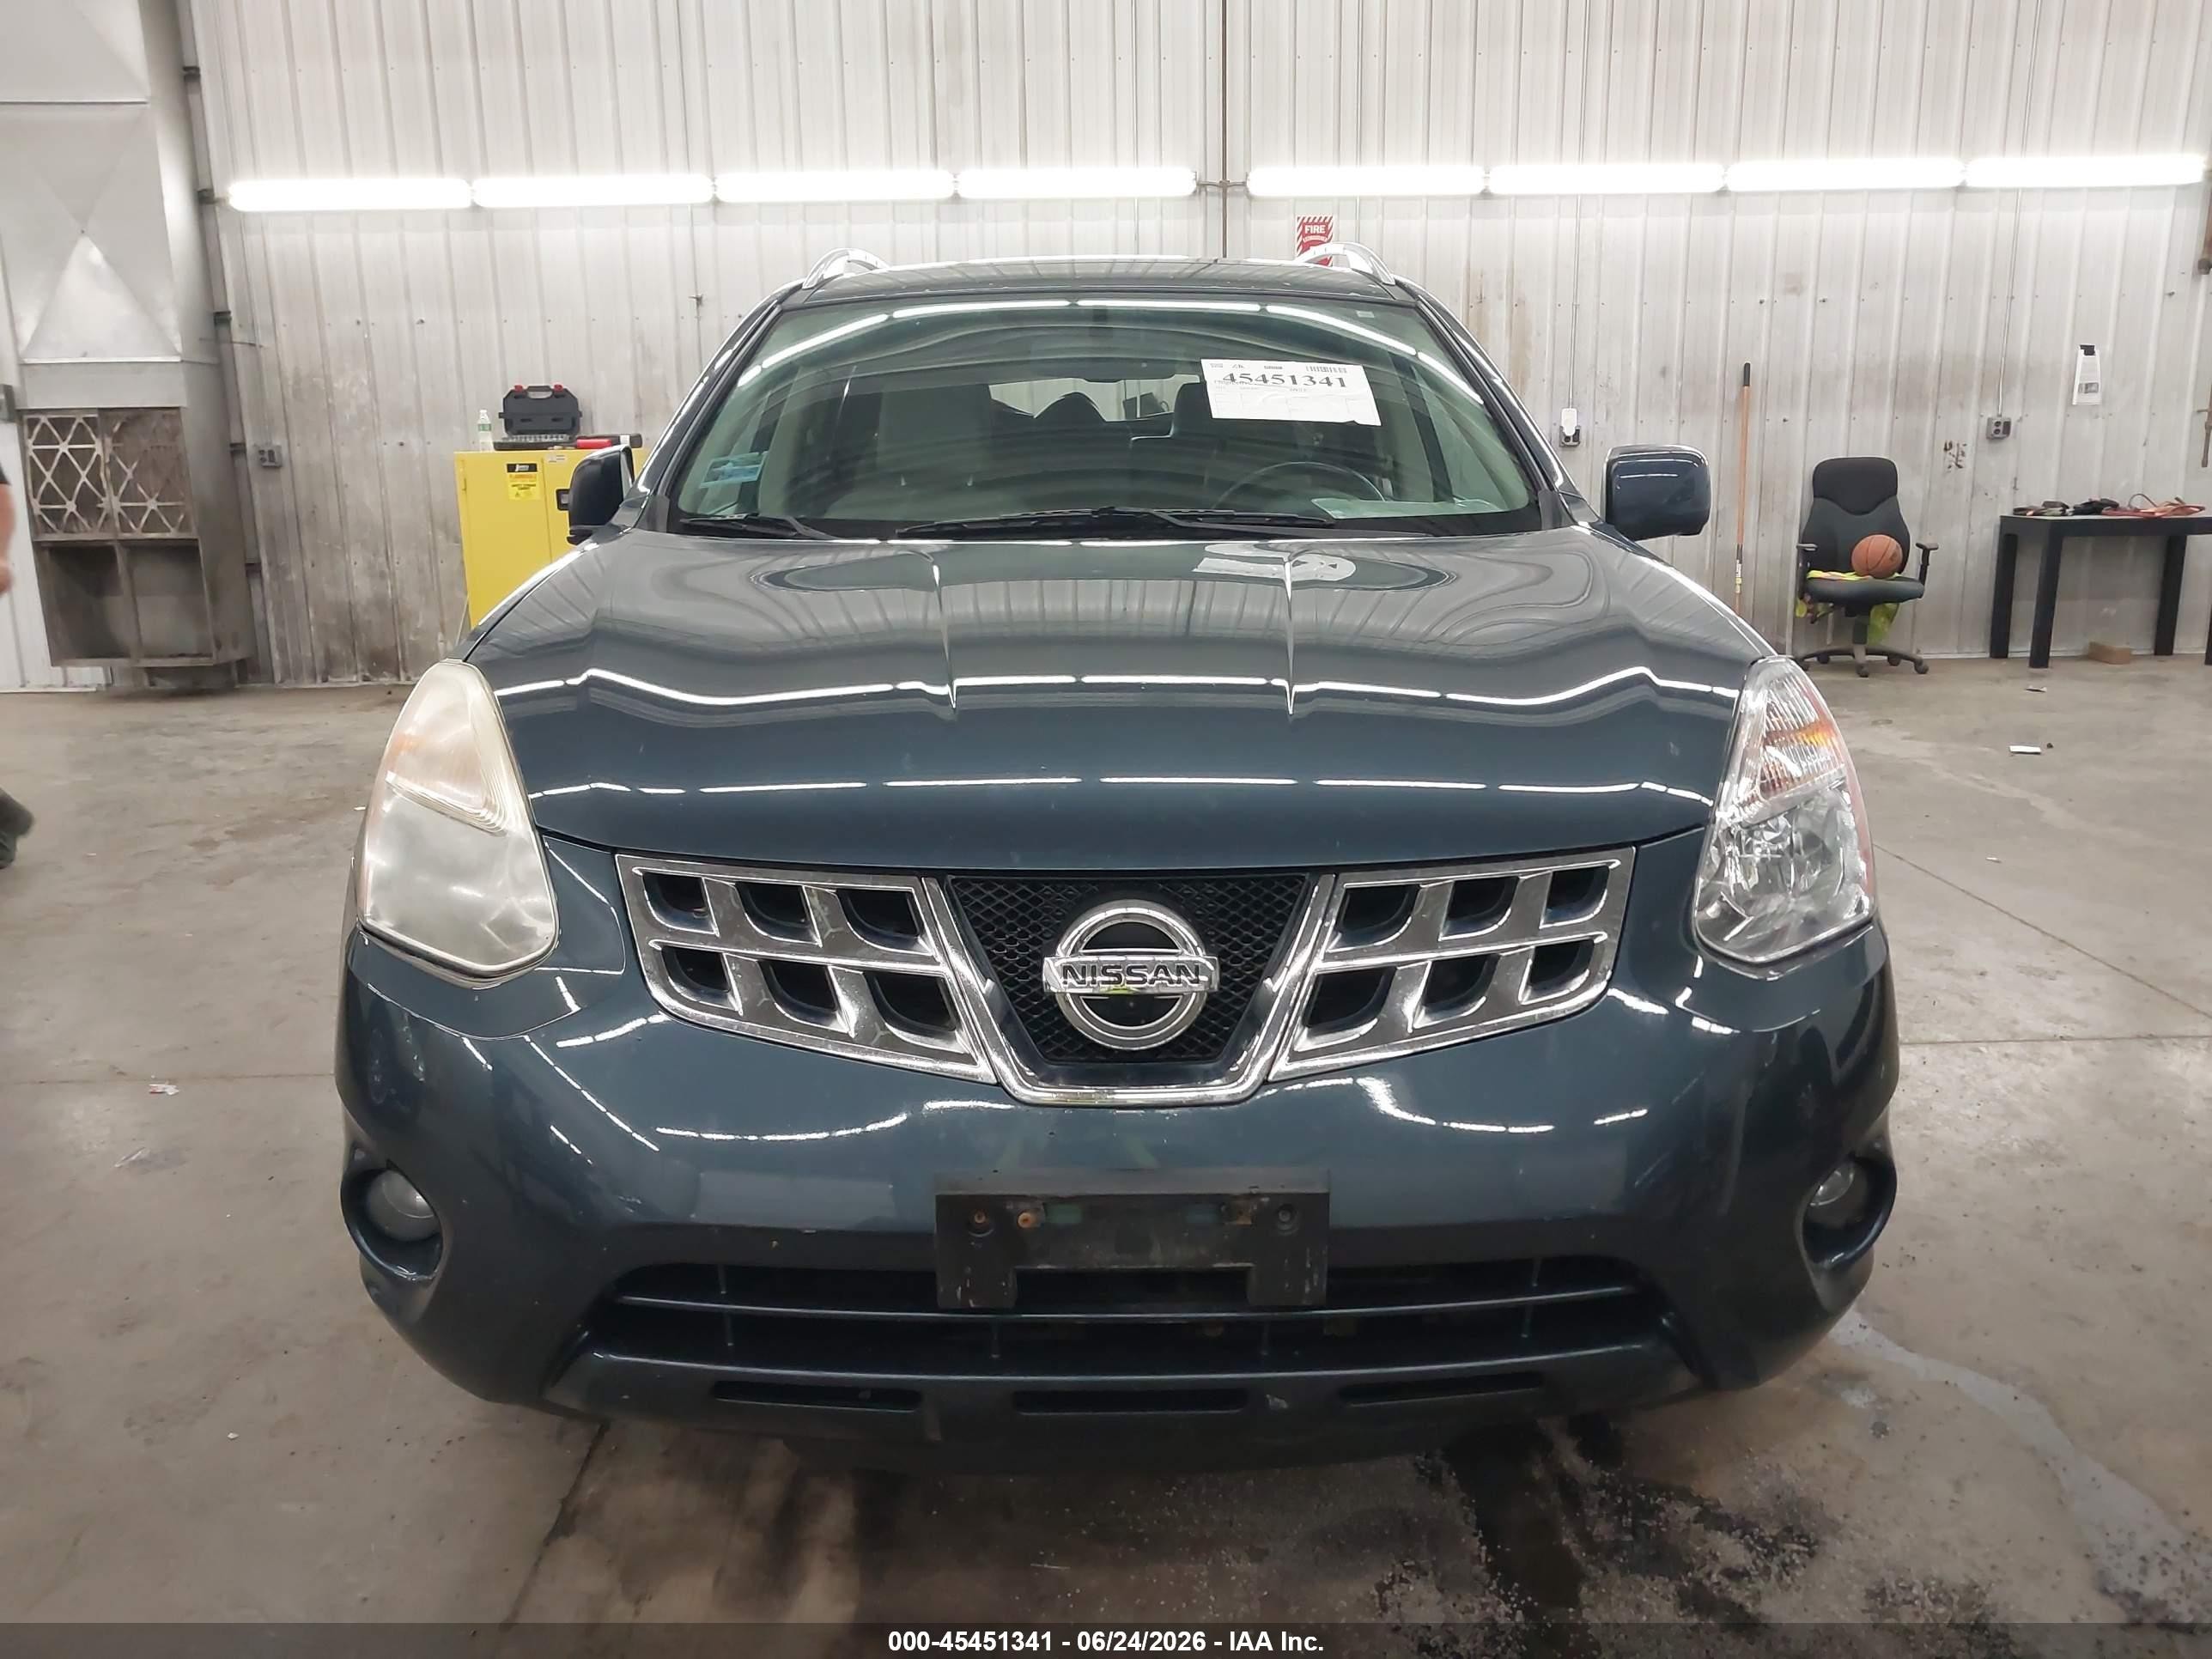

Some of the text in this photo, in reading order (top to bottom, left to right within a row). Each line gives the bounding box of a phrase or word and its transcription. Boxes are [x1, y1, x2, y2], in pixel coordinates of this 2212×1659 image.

[1304, 224, 1326, 234] FIRE
[1223, 372, 1347, 388] 45451341
[1061, 963, 1200, 987] NISSAN
